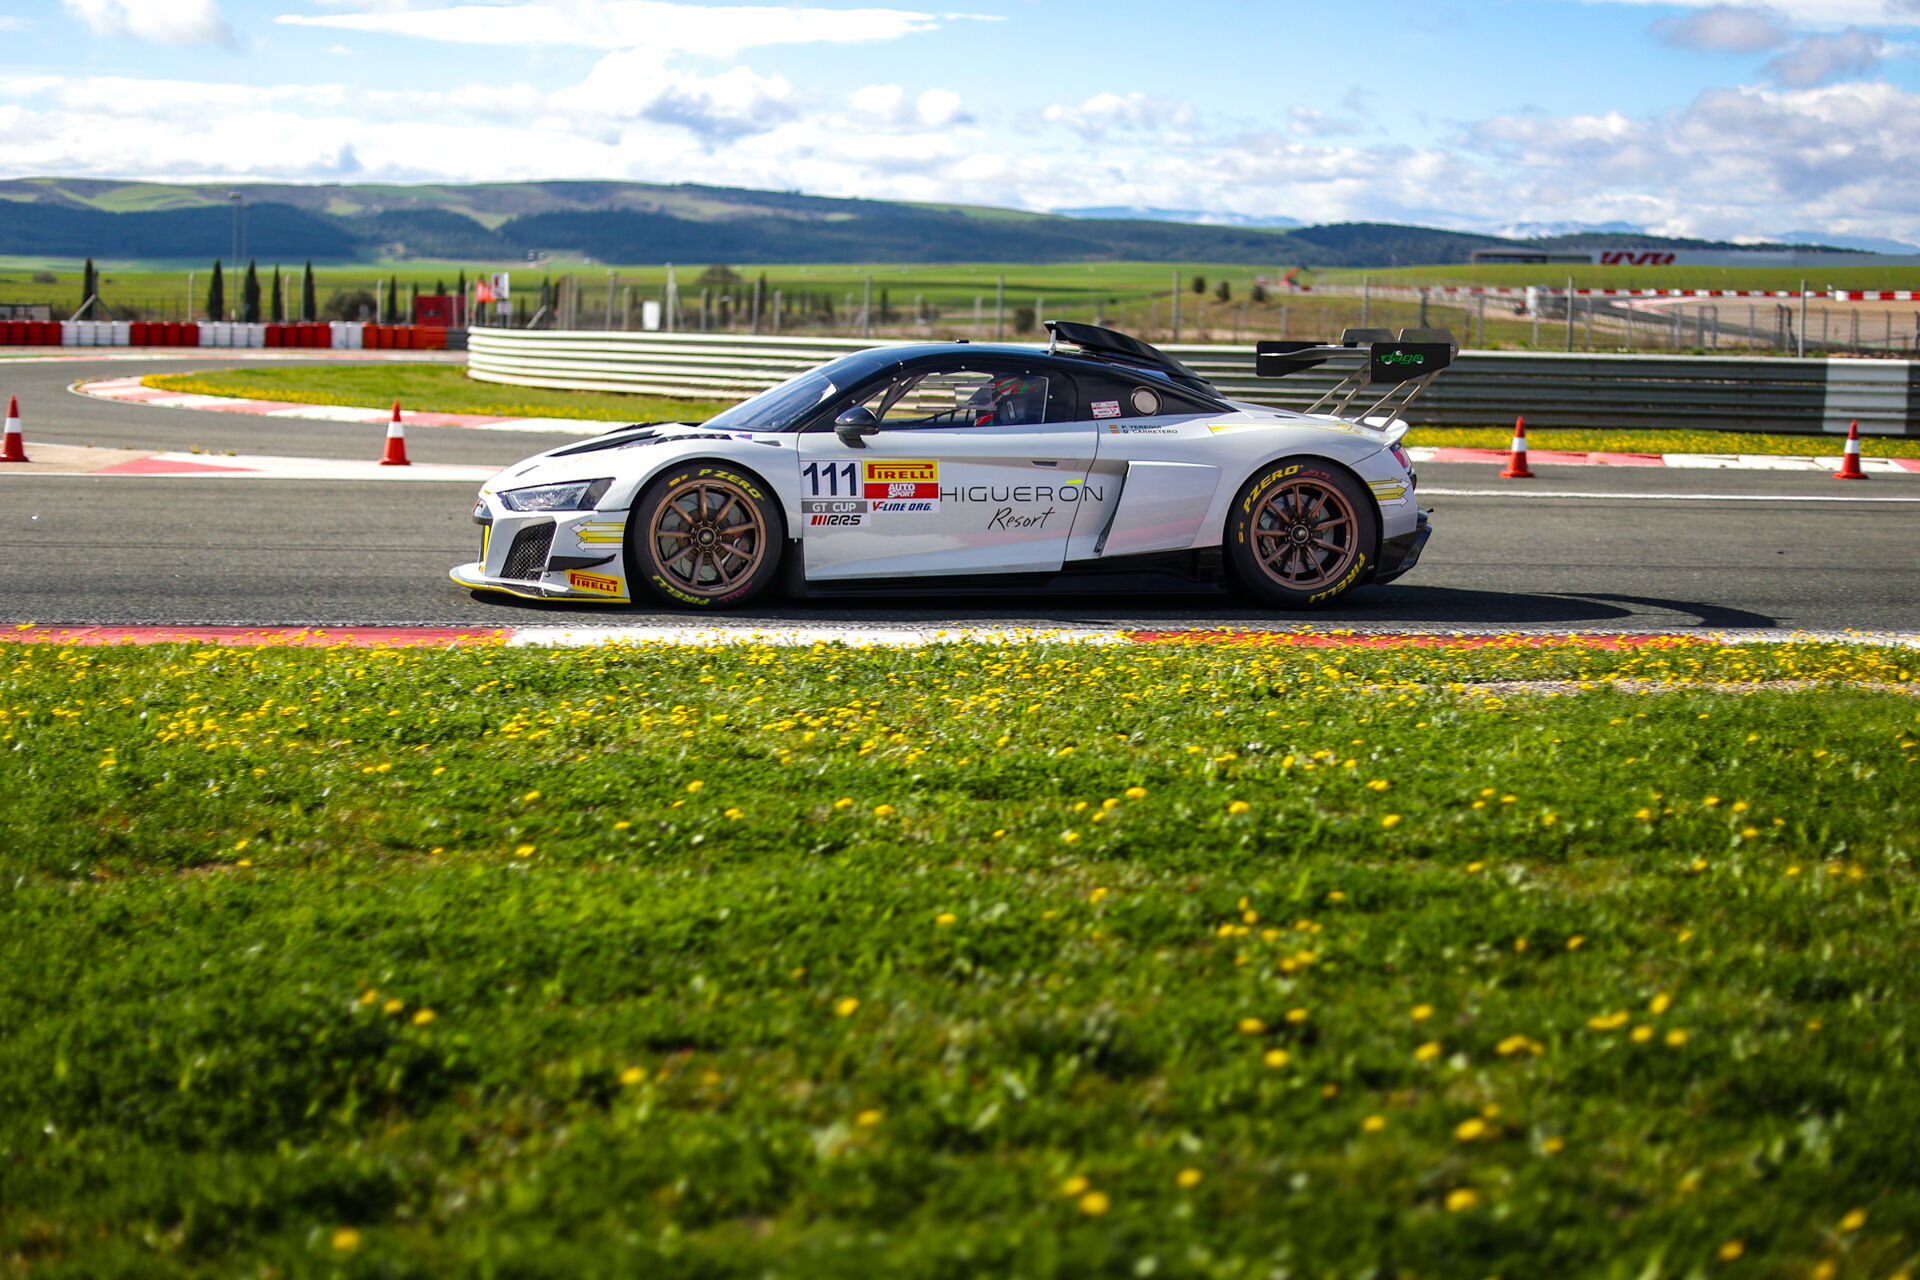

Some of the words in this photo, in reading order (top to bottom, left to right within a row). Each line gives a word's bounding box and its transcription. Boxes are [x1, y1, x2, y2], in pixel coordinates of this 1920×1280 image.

[867, 463, 934, 479] PIRELLI
[803, 462, 857, 497] 111
[888, 483, 916, 492] AUTO
[887, 490, 915, 498] SPORT
[812, 502, 827, 512] GT
[832, 502, 857, 512] CUP
[872, 501, 906, 512] V-LINE
[987, 506, 1055, 531] Resort
[570, 573, 618, 592] PIRELLI
[1309, 552, 1366, 603] PIRELLI
